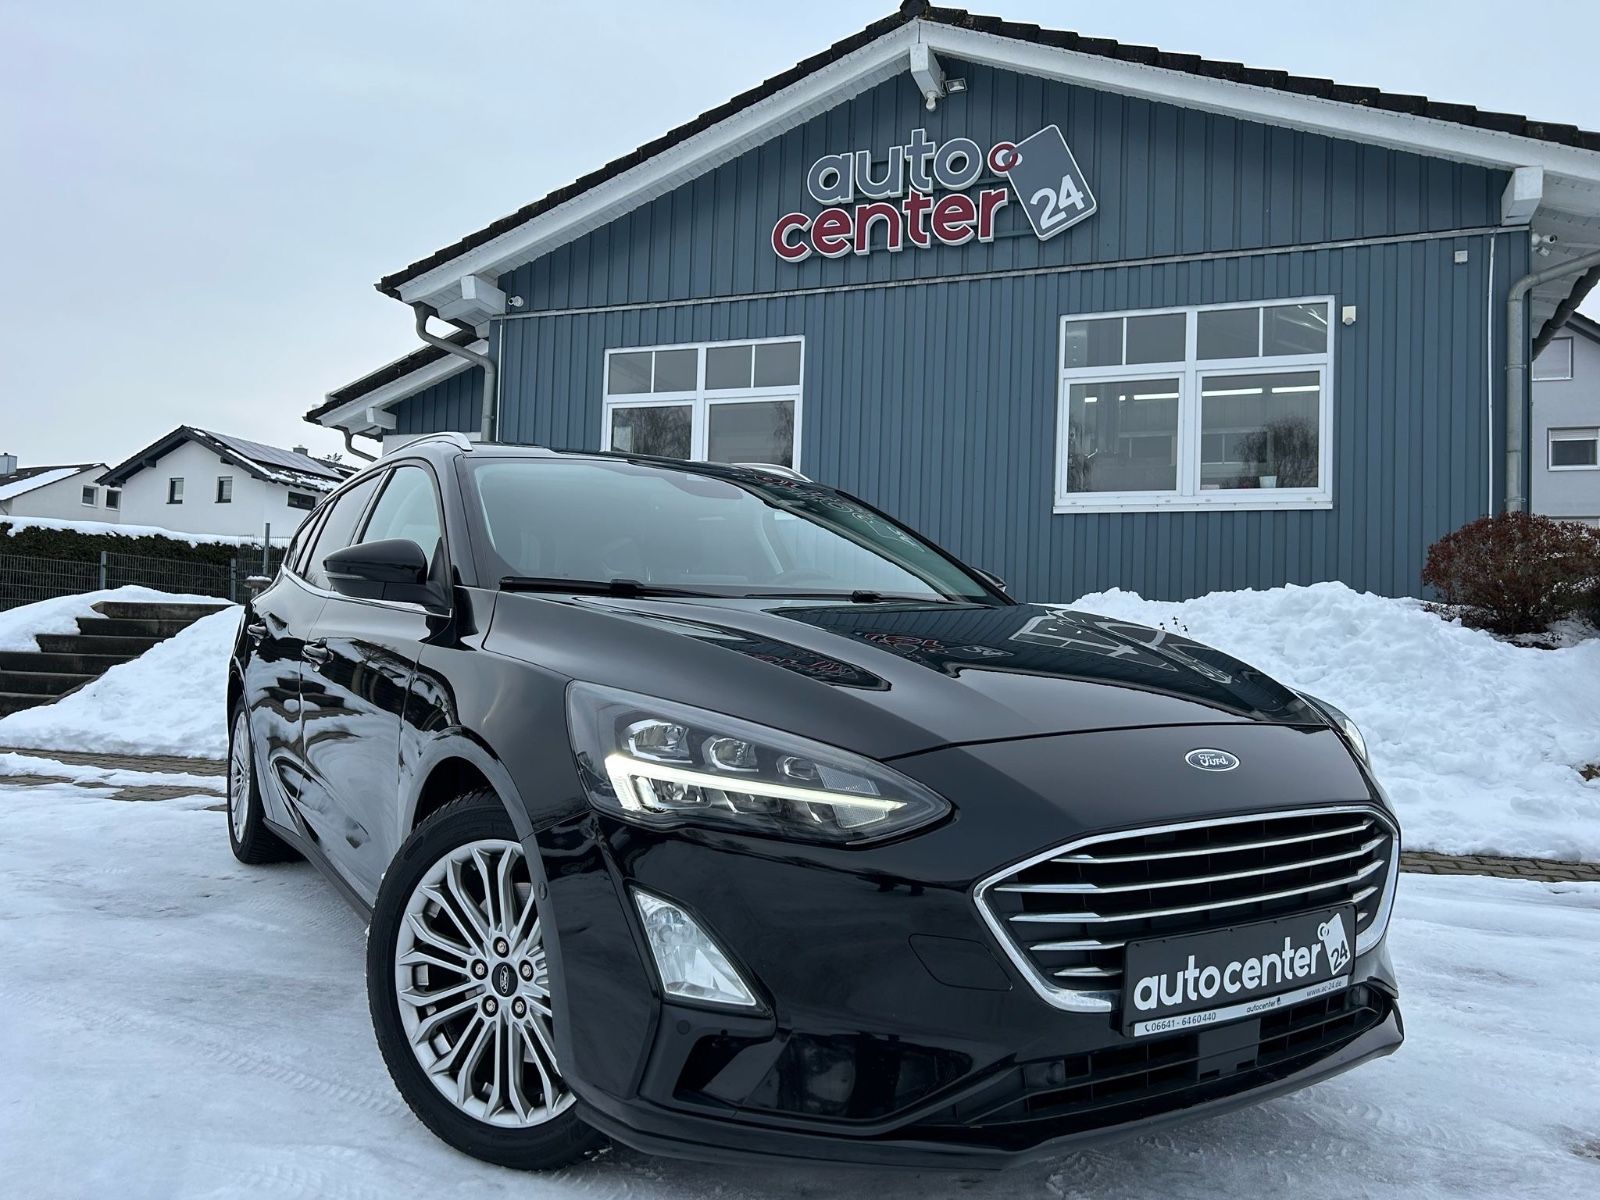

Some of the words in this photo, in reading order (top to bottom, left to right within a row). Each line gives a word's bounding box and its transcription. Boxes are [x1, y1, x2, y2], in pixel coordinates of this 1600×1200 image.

[807, 128, 983, 205] auto
[1030, 174, 1085, 230] 24
[771, 187, 1008, 262] center
[1198, 753, 1229, 767] Ford
[1134, 937, 1321, 1011] autocenter
[1331, 940, 1348, 971] 24
